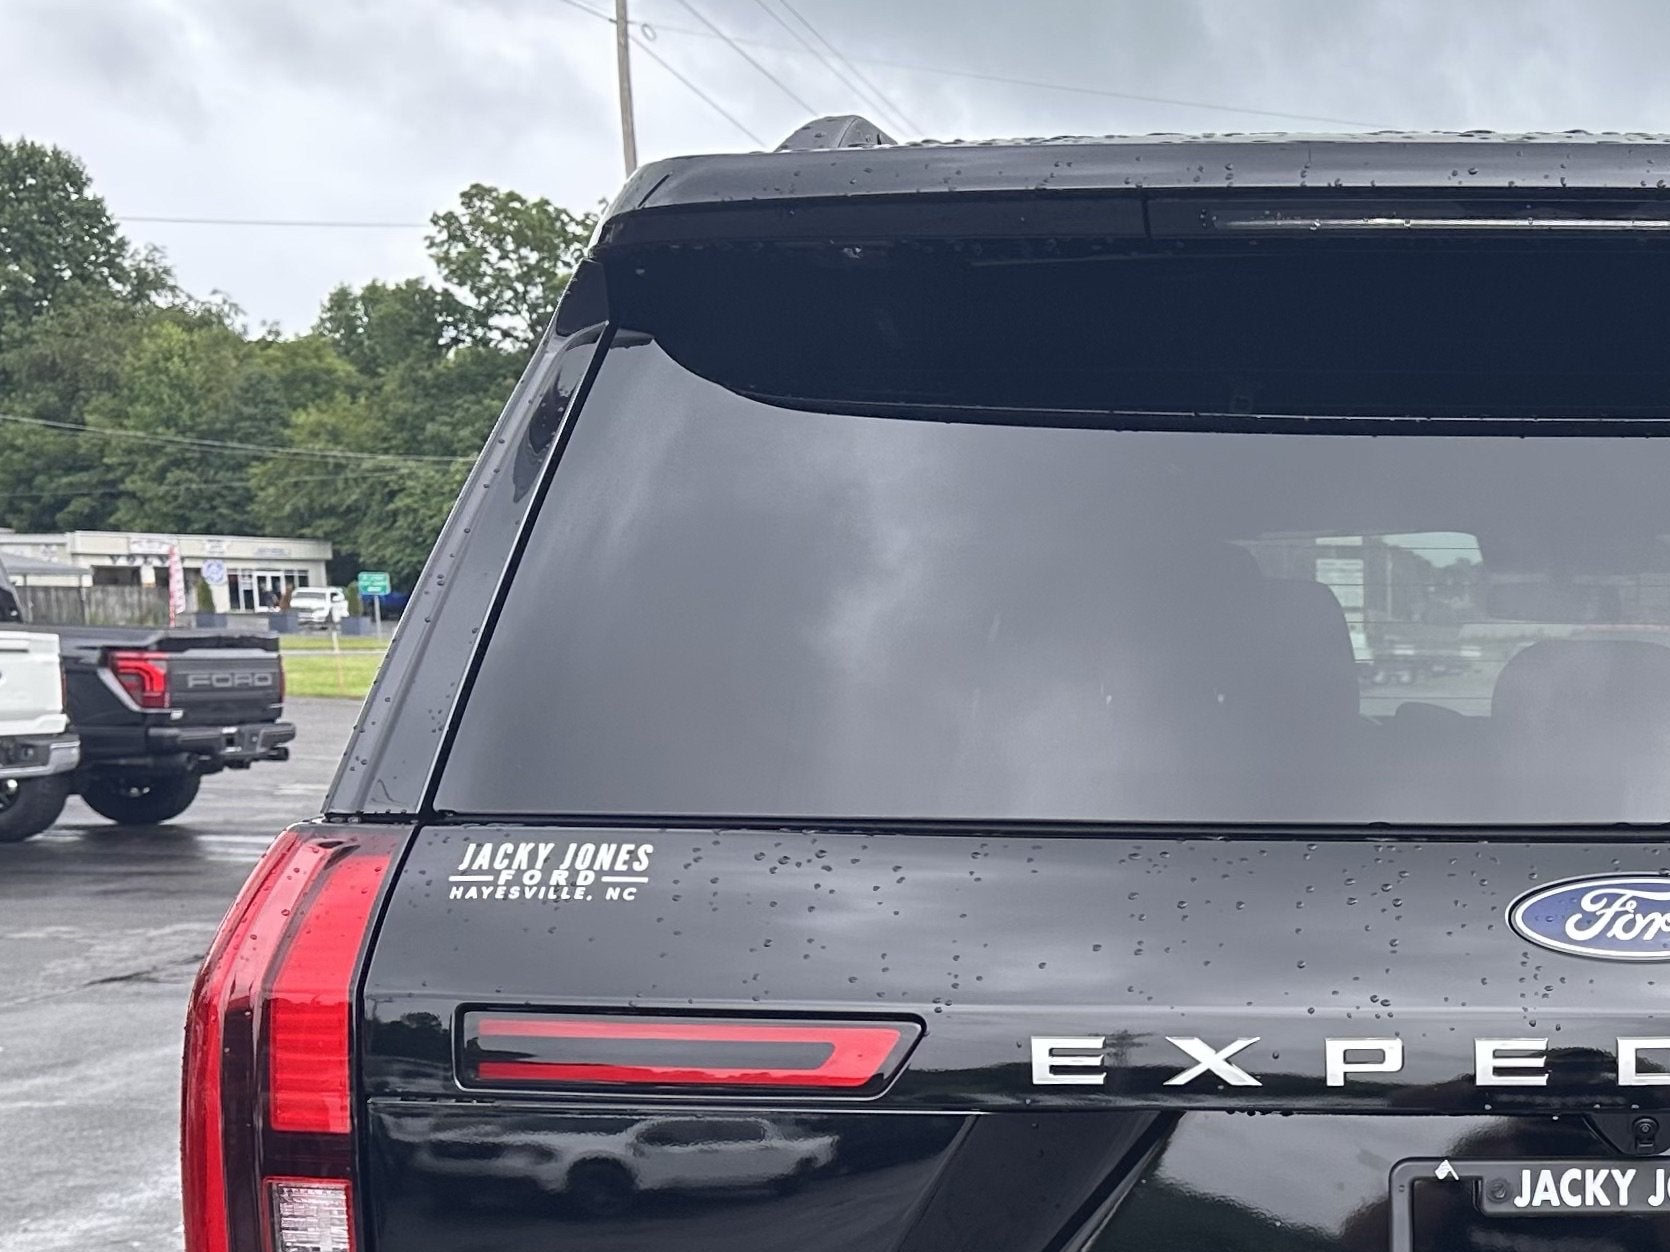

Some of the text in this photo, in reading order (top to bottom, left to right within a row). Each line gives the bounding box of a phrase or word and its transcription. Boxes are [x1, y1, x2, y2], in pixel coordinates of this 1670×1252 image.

[187, 673, 272, 688] FORD
[457, 842, 654, 872] JACKY JONES
[497, 869, 596, 886] FORD
[605, 887, 637, 901] NC
[1513, 1168, 1637, 1208] JACKY
